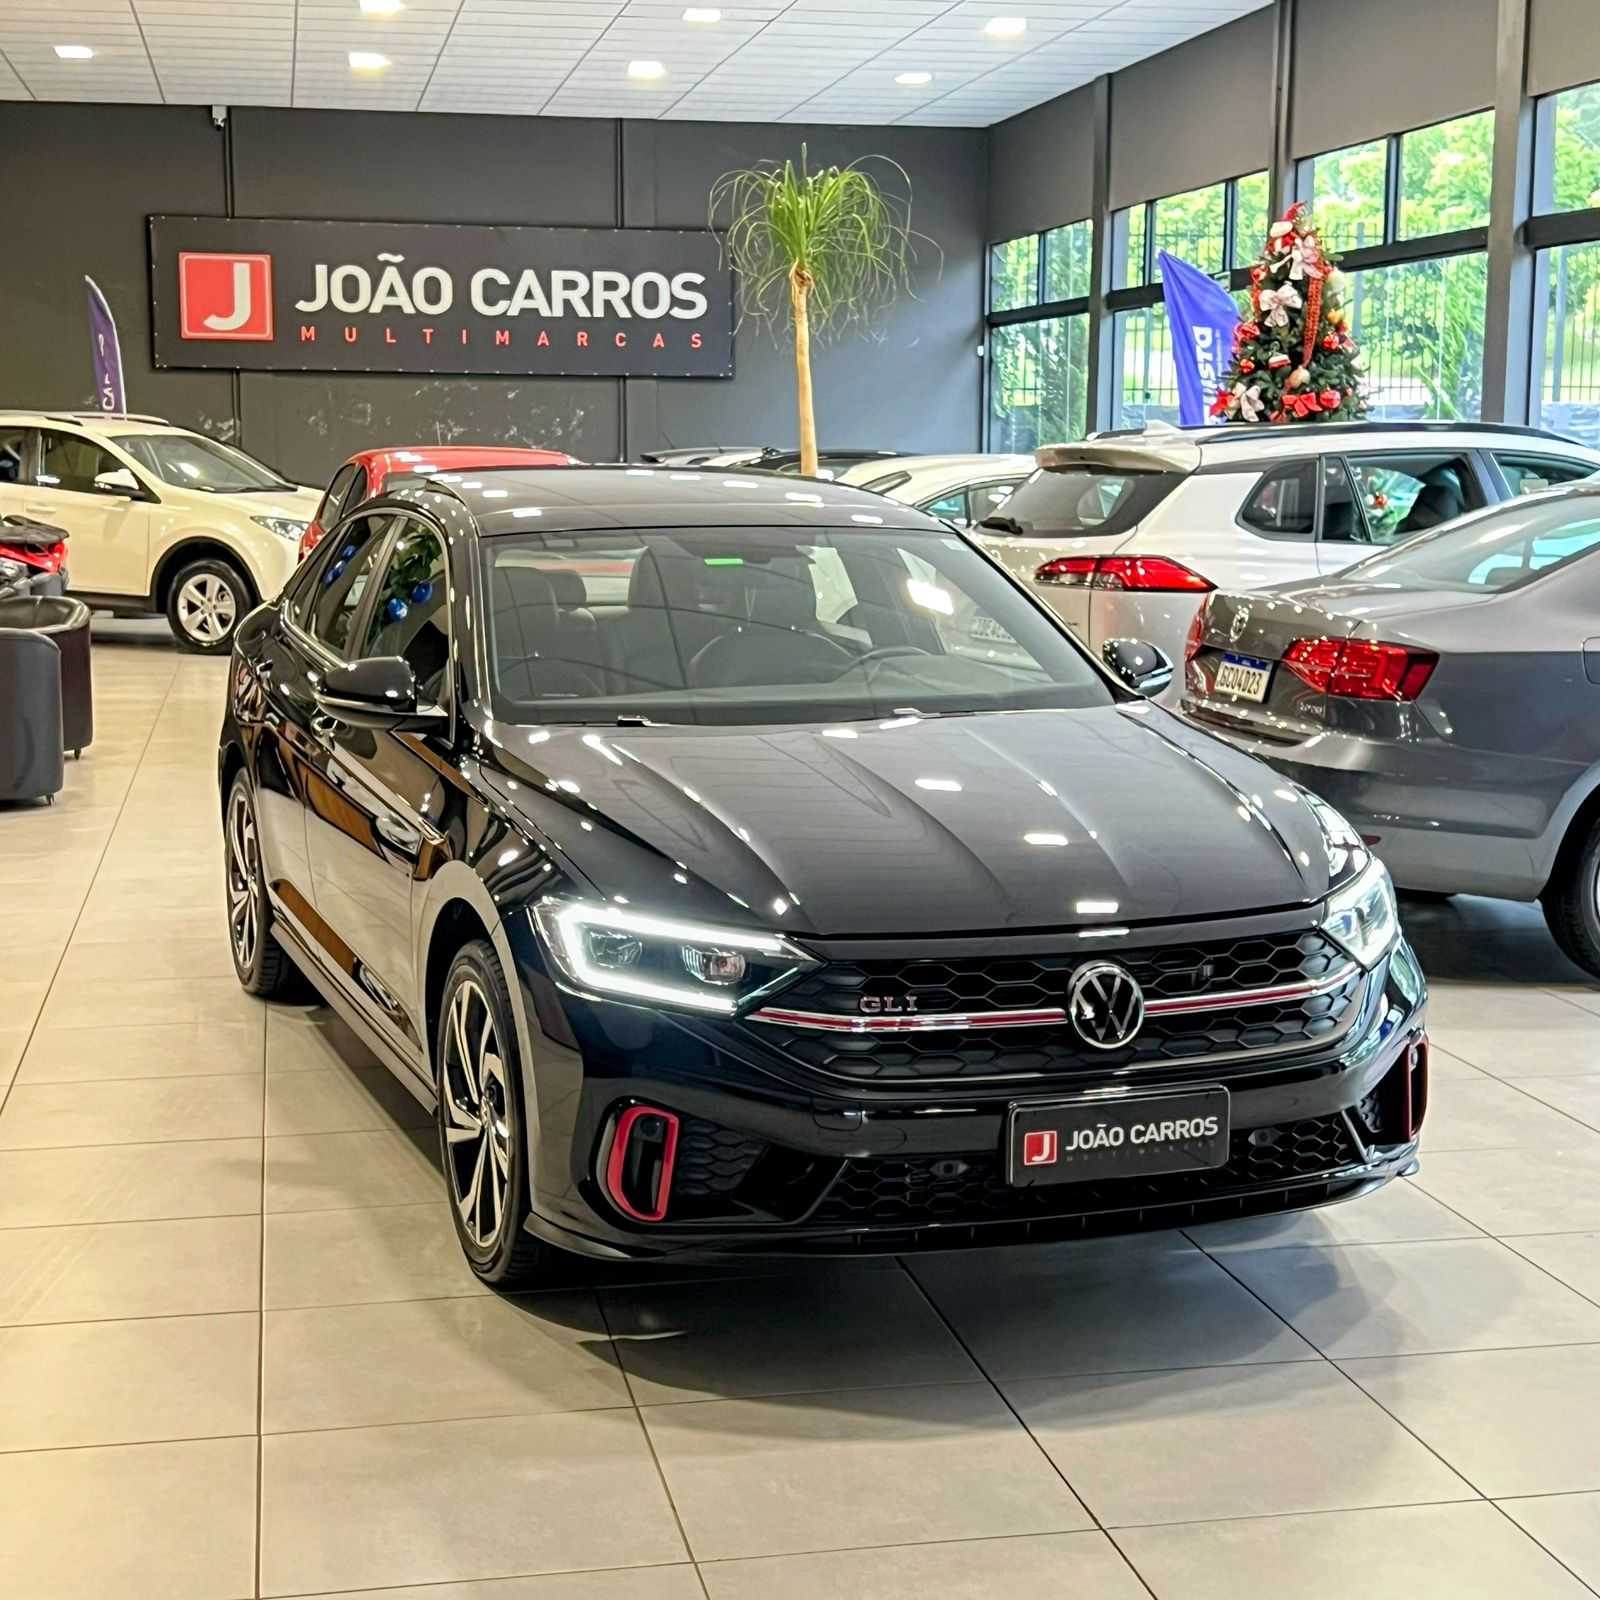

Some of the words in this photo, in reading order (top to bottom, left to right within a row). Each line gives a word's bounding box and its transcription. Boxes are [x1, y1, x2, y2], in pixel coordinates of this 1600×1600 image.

[203, 262, 251, 331] J
[294, 253, 453, 315] JOÃO
[470, 268, 708, 320] CARROS
[300, 325, 703, 348] MULTIMARCAS
[859, 995, 918, 1013] GLI
[1031, 1133, 1050, 1162] J
[1065, 1123, 1125, 1151] JOÃO
[1130, 1116, 1219, 1145] CARROS
